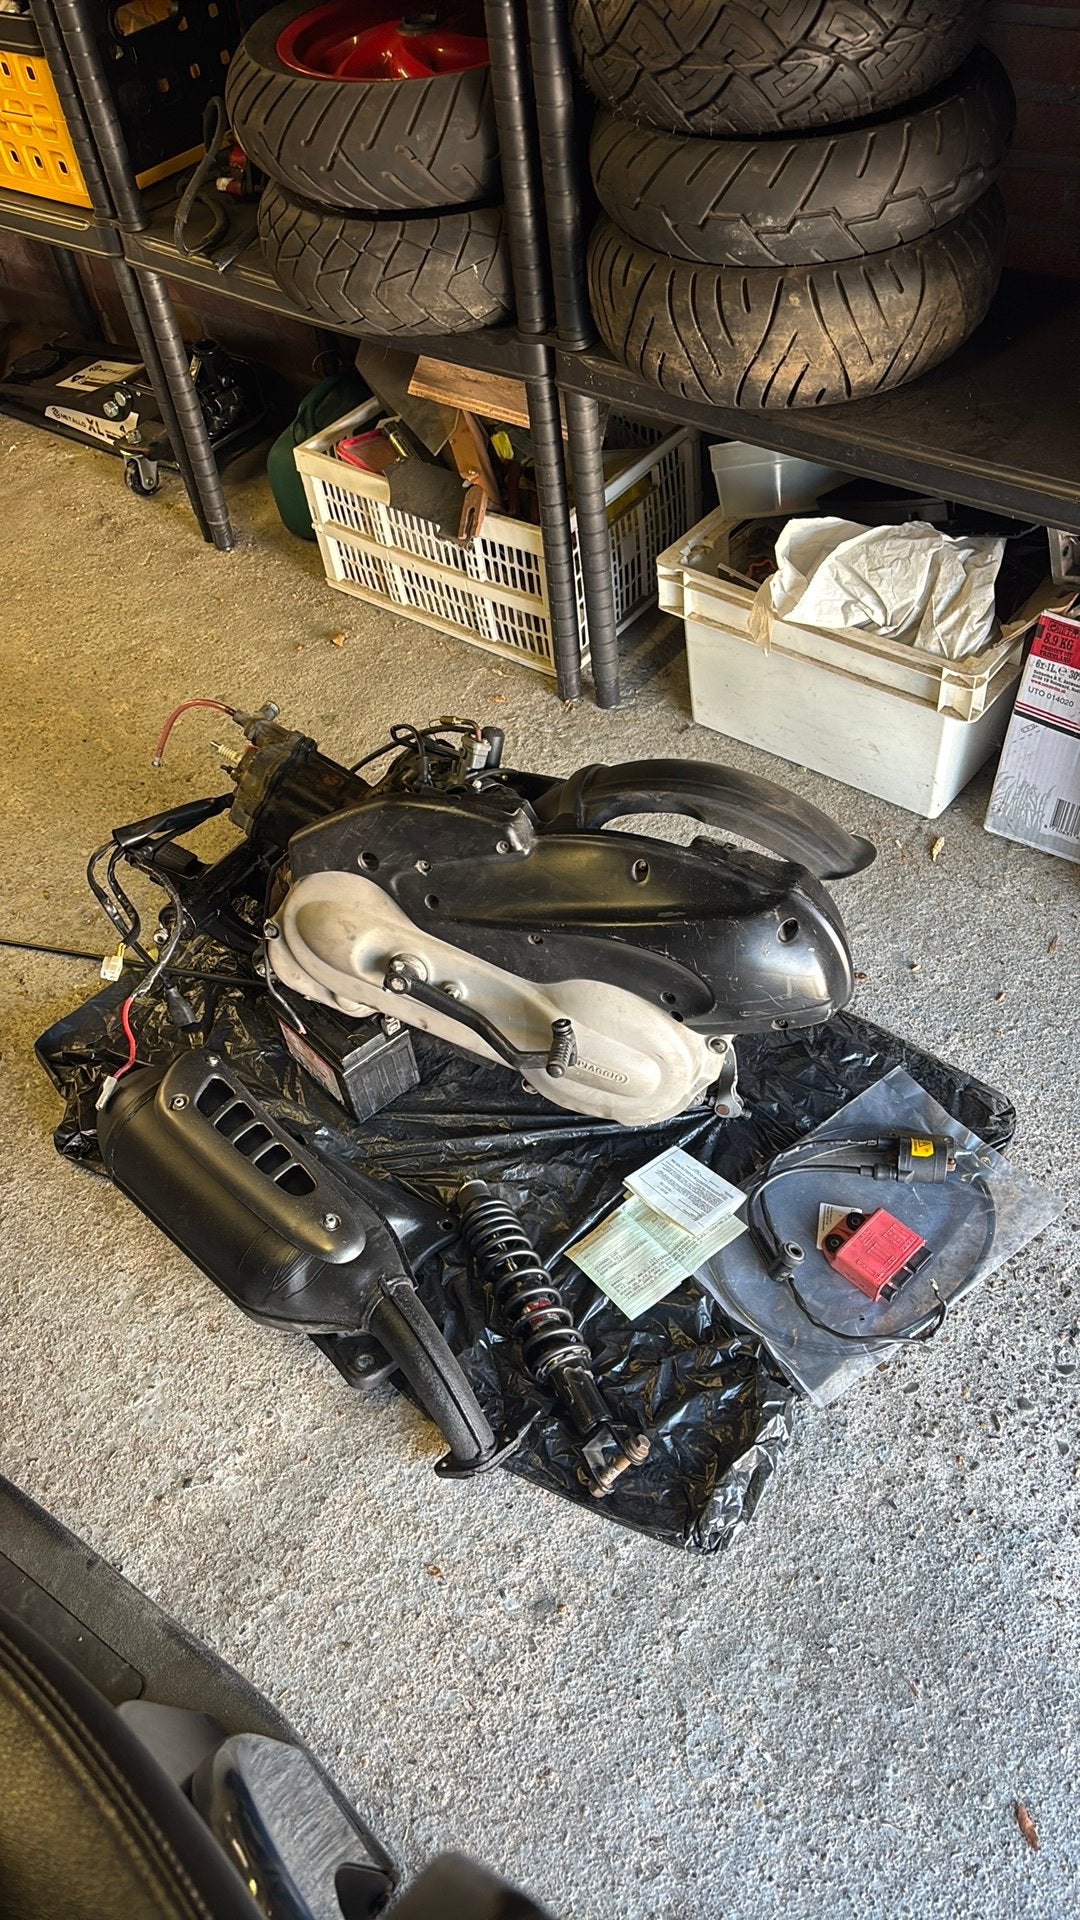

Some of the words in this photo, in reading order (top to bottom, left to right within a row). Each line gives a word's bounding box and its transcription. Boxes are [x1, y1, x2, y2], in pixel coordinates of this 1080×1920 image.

[86, 416, 105, 437] XL
[1043, 632, 1058, 646] 8.9
[1060, 637, 1074, 651] KG
[1028, 686, 1045, 698] UTO
[1046, 692, 1075, 708] 014020
[576, 1059, 629, 1083] PIAGGIO
